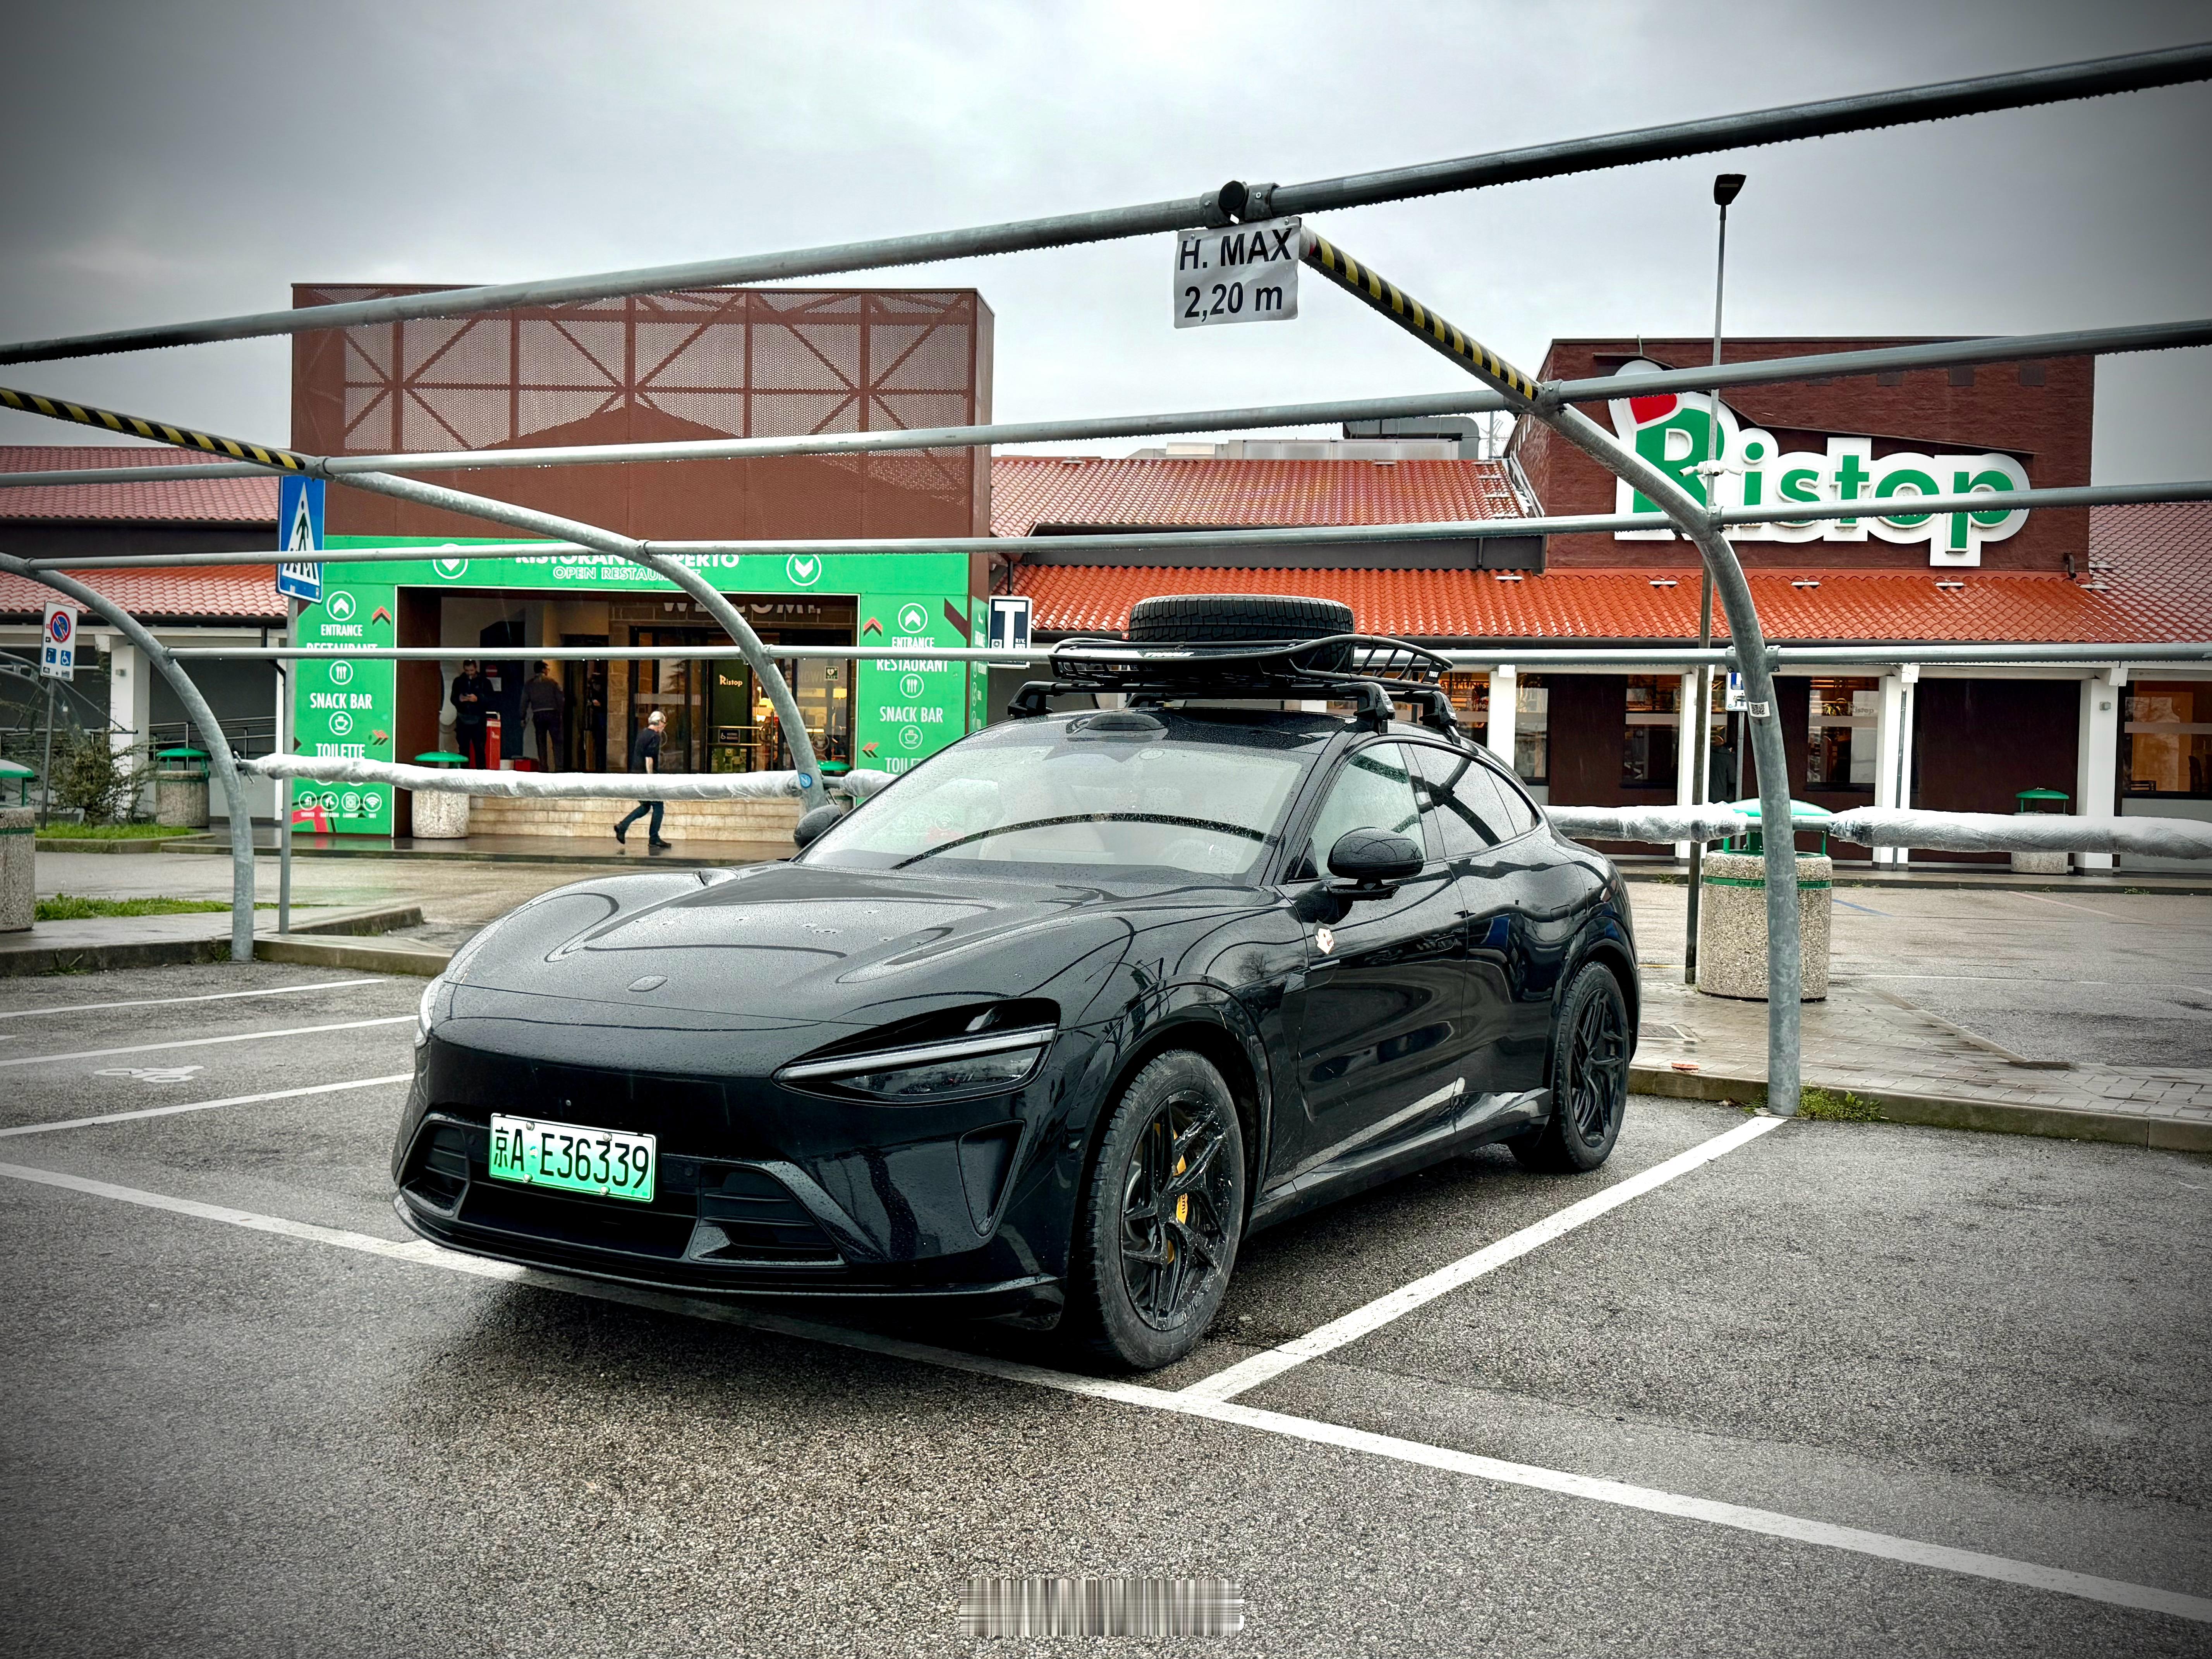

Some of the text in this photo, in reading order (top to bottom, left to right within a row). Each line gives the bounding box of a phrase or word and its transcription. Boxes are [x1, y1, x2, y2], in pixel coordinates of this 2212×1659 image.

[1180, 228, 1292, 270] H. MAX
[1184, 282, 1282, 322] 2,20 m
[1630, 391, 2017, 553] Ristop
[553, 566, 597, 580] OPEN
[321, 624, 363, 636] ENTRANCE
[892, 637, 935, 648] ENTRANCE
[876, 659, 948, 672] RESTAURANT
[719, 674, 743, 687] Ristop
[310, 692, 373, 709] SNACK BAR
[879, 706, 943, 723] SNACK BAR
[316, 743, 366, 758] TOILETTE
[494, 1126, 649, 1189] 京A E36339
